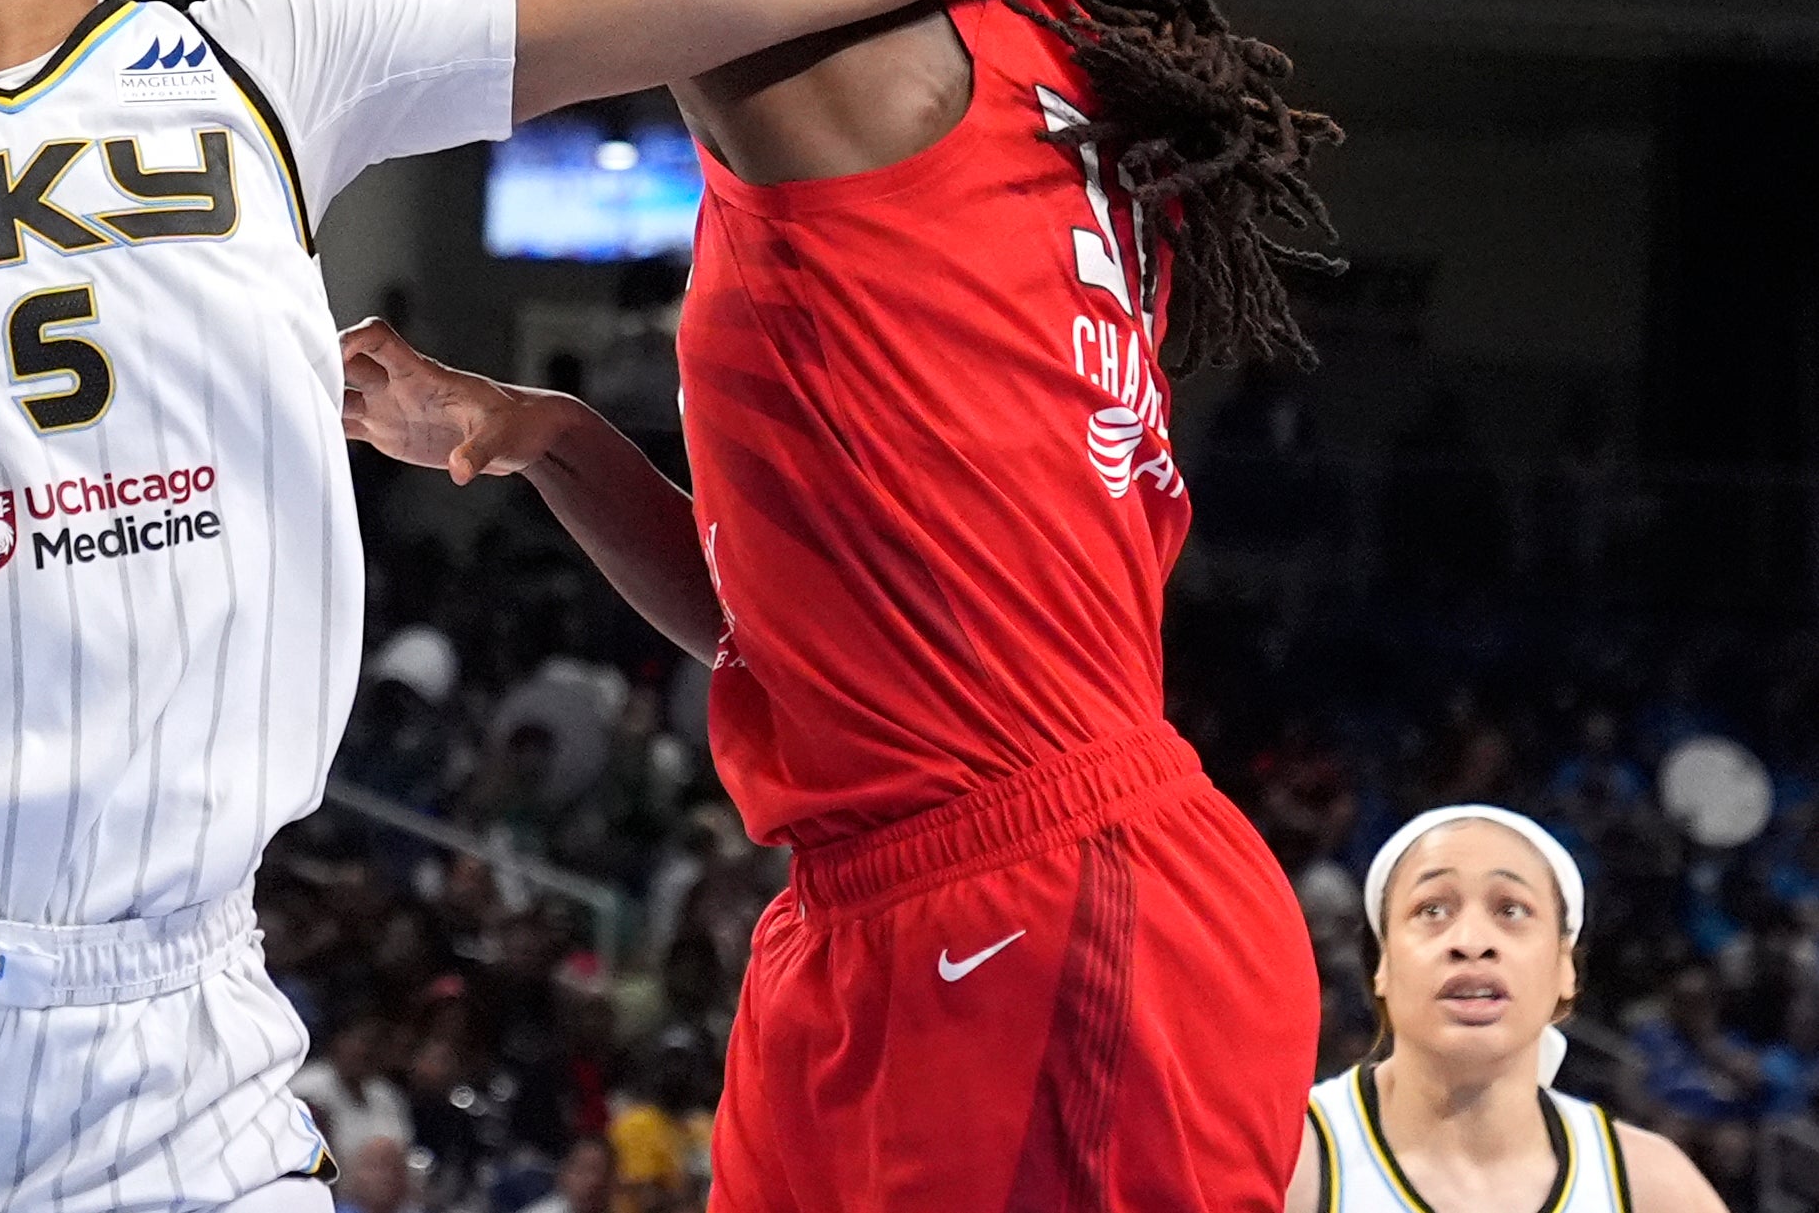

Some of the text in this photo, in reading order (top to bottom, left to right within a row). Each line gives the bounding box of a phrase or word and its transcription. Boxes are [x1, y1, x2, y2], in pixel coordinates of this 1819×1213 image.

[121, 73, 215, 88] MAGELLAN
[3, 282, 116, 436] 5
[24, 466, 215, 520] UChicago
[32, 509, 221, 569] Medicine
